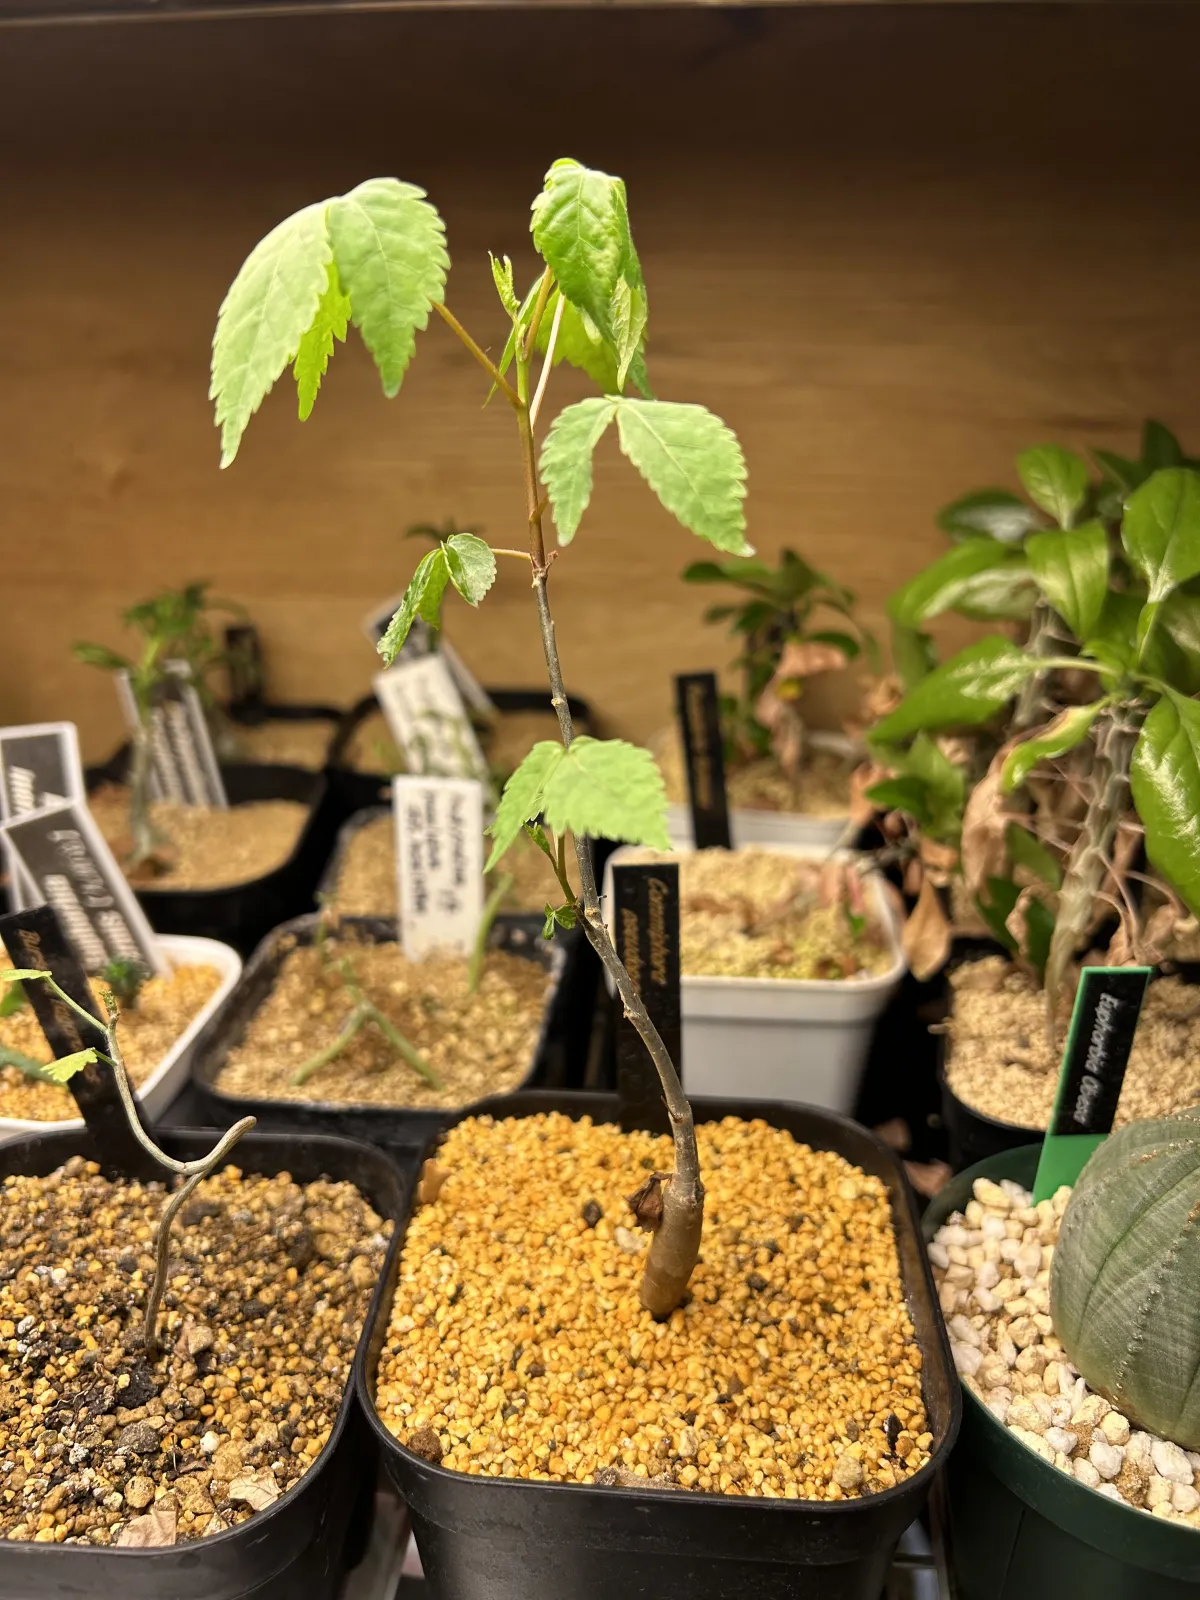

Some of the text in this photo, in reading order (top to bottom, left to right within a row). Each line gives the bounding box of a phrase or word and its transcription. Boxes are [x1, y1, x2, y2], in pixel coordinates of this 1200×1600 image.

[646, 877, 669, 985] Commiphora
[1073, 992, 1120, 1125] Euphorbia Obesa
